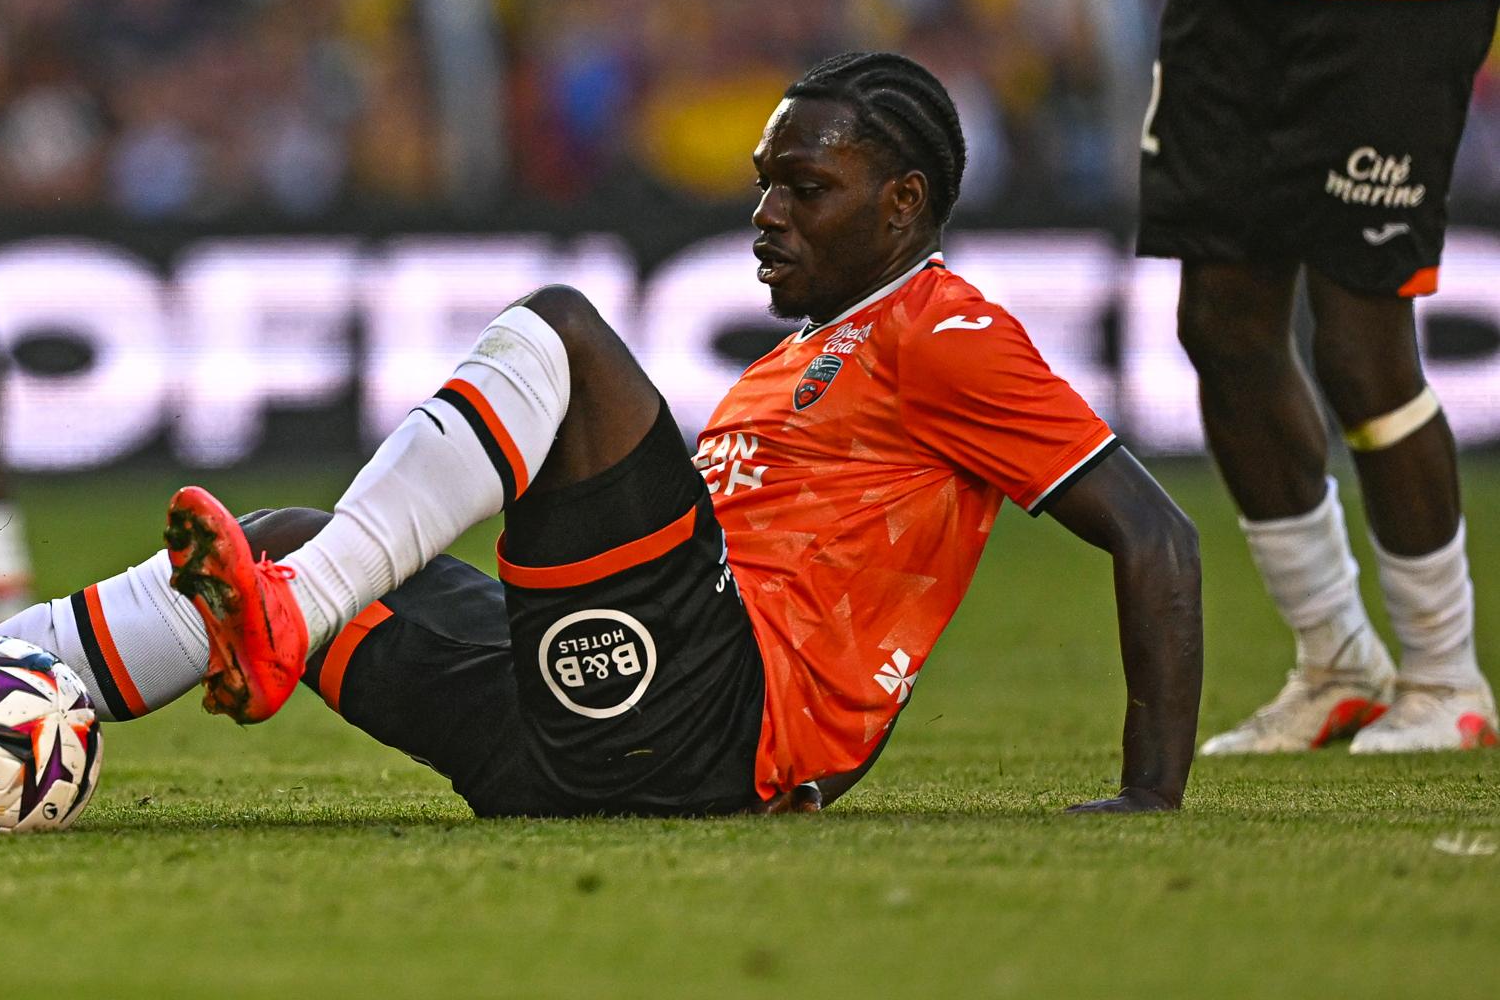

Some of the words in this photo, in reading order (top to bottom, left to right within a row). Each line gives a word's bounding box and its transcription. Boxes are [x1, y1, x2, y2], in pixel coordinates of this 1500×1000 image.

[1346, 146, 1412, 184] Cité
[1325, 170, 1426, 208] marine
[690, 433, 759, 471] EAN
[558, 628, 625, 654] HOTELS
[555, 641, 642, 688] B&B
